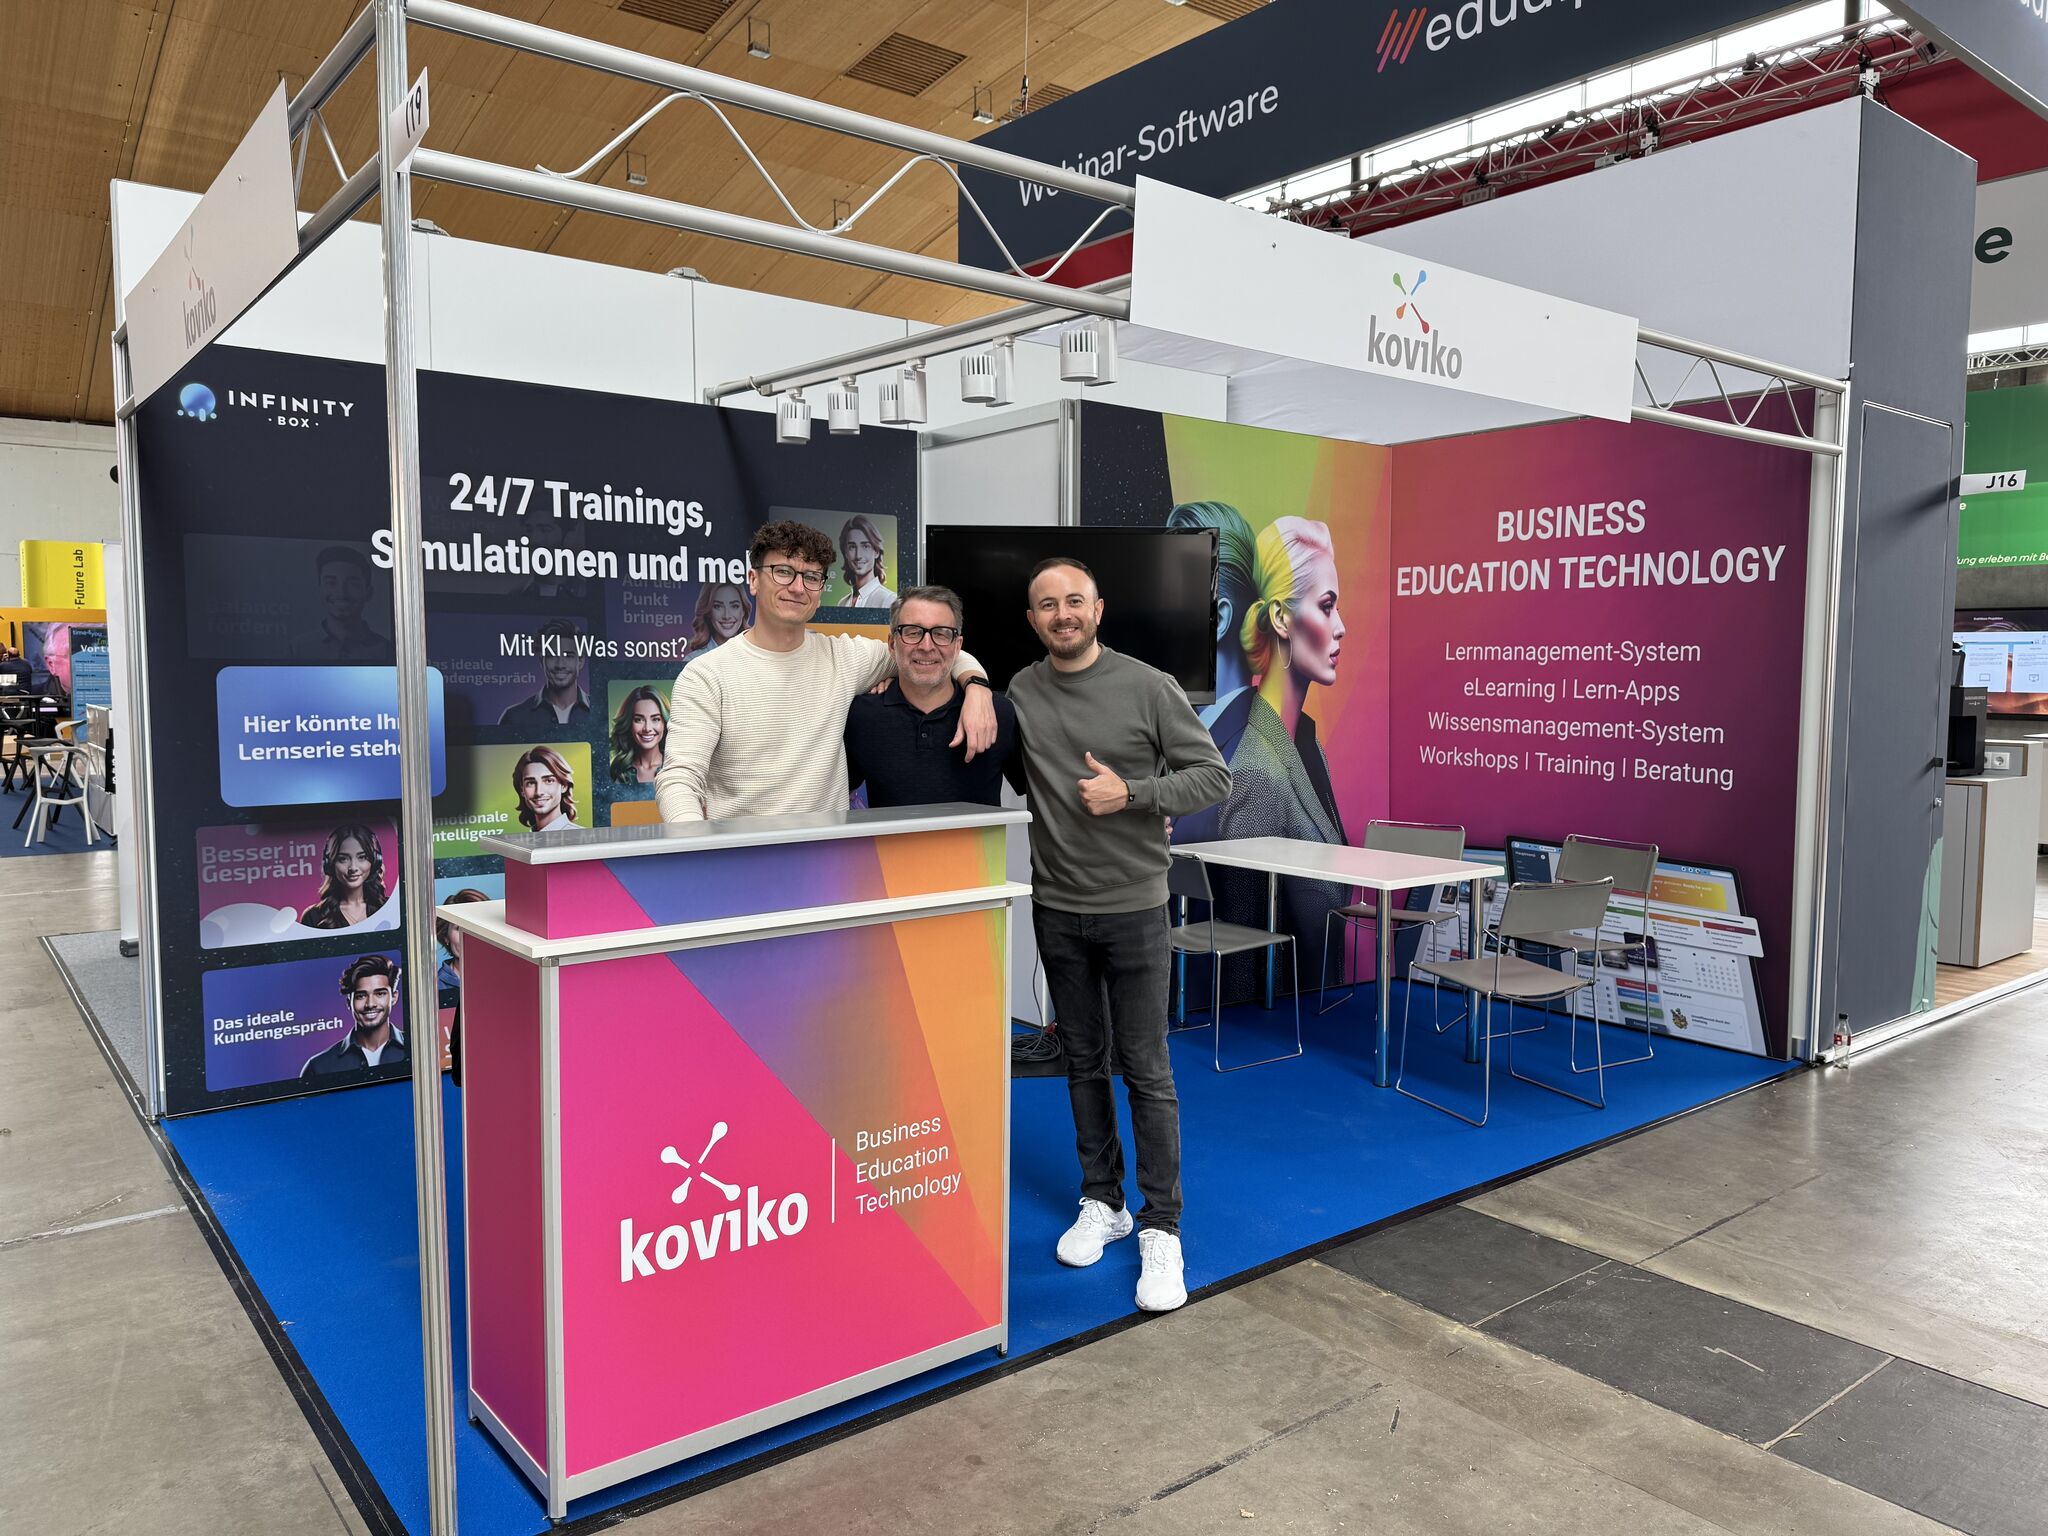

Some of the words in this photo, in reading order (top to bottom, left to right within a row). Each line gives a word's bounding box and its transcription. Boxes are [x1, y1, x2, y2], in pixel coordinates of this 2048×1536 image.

[182, 286, 217, 349] koviko
[1367, 314, 1462, 379] koviko
[228, 390, 355, 417] INFINITY
[277, 415, 310, 428] BOX
[1986, 474, 2018, 489] J16
[449, 472, 535, 517] 24/7
[544, 480, 712, 537] Trainings,
[1497, 499, 1646, 543] BUSINESS
[73, 549, 84, 568] Lab
[371, 529, 618, 579] Smulationen
[628, 545, 688, 582] und
[1956, 556, 1977, 566] ung
[1978, 555, 2017, 563] erleben
[2019, 553, 2038, 562] mit
[1397, 558, 1551, 596] EDUCATION
[1558, 545, 1786, 589] TECHNOLOGY
[74, 571, 86, 605] Future
[623, 591, 669, 606] Punkt
[623, 609, 683, 628] bringen
[80, 645, 110, 653] Vort
[500, 633, 535, 657] Mit
[541, 634, 567, 657] KI.
[574, 635, 618, 657] Was
[624, 636, 689, 659] sonst?
[1445, 640, 1701, 667] Lernmanagement-System
[443, 672, 536, 685] dengespräch
[1463, 677, 1555, 703] eLearning
[1573, 679, 1680, 706] Lern-Apps
[244, 715, 291, 733] Hier
[297, 714, 372, 732] könnte
[1427, 711, 1724, 745] Wissensmanagement-System
[239, 741, 345, 761] Lernserie
[1419, 745, 1518, 773] Workshops
[1535, 752, 1615, 782] Training
[1634, 758, 1734, 791] Beratung
[432, 810, 508, 827] motionale
[201, 846, 284, 864] Besser
[289, 841, 316, 858] im
[202, 859, 313, 884] Gespräch
[213, 1018, 243, 1031] Das
[247, 1010, 295, 1026] ideale
[214, 1017, 343, 1046] Kundengespräch
[856, 1116, 942, 1152] Business
[856, 1145, 949, 1184] Education
[855, 1171, 962, 1215] Technology
[620, 1185, 808, 1283] koviko
